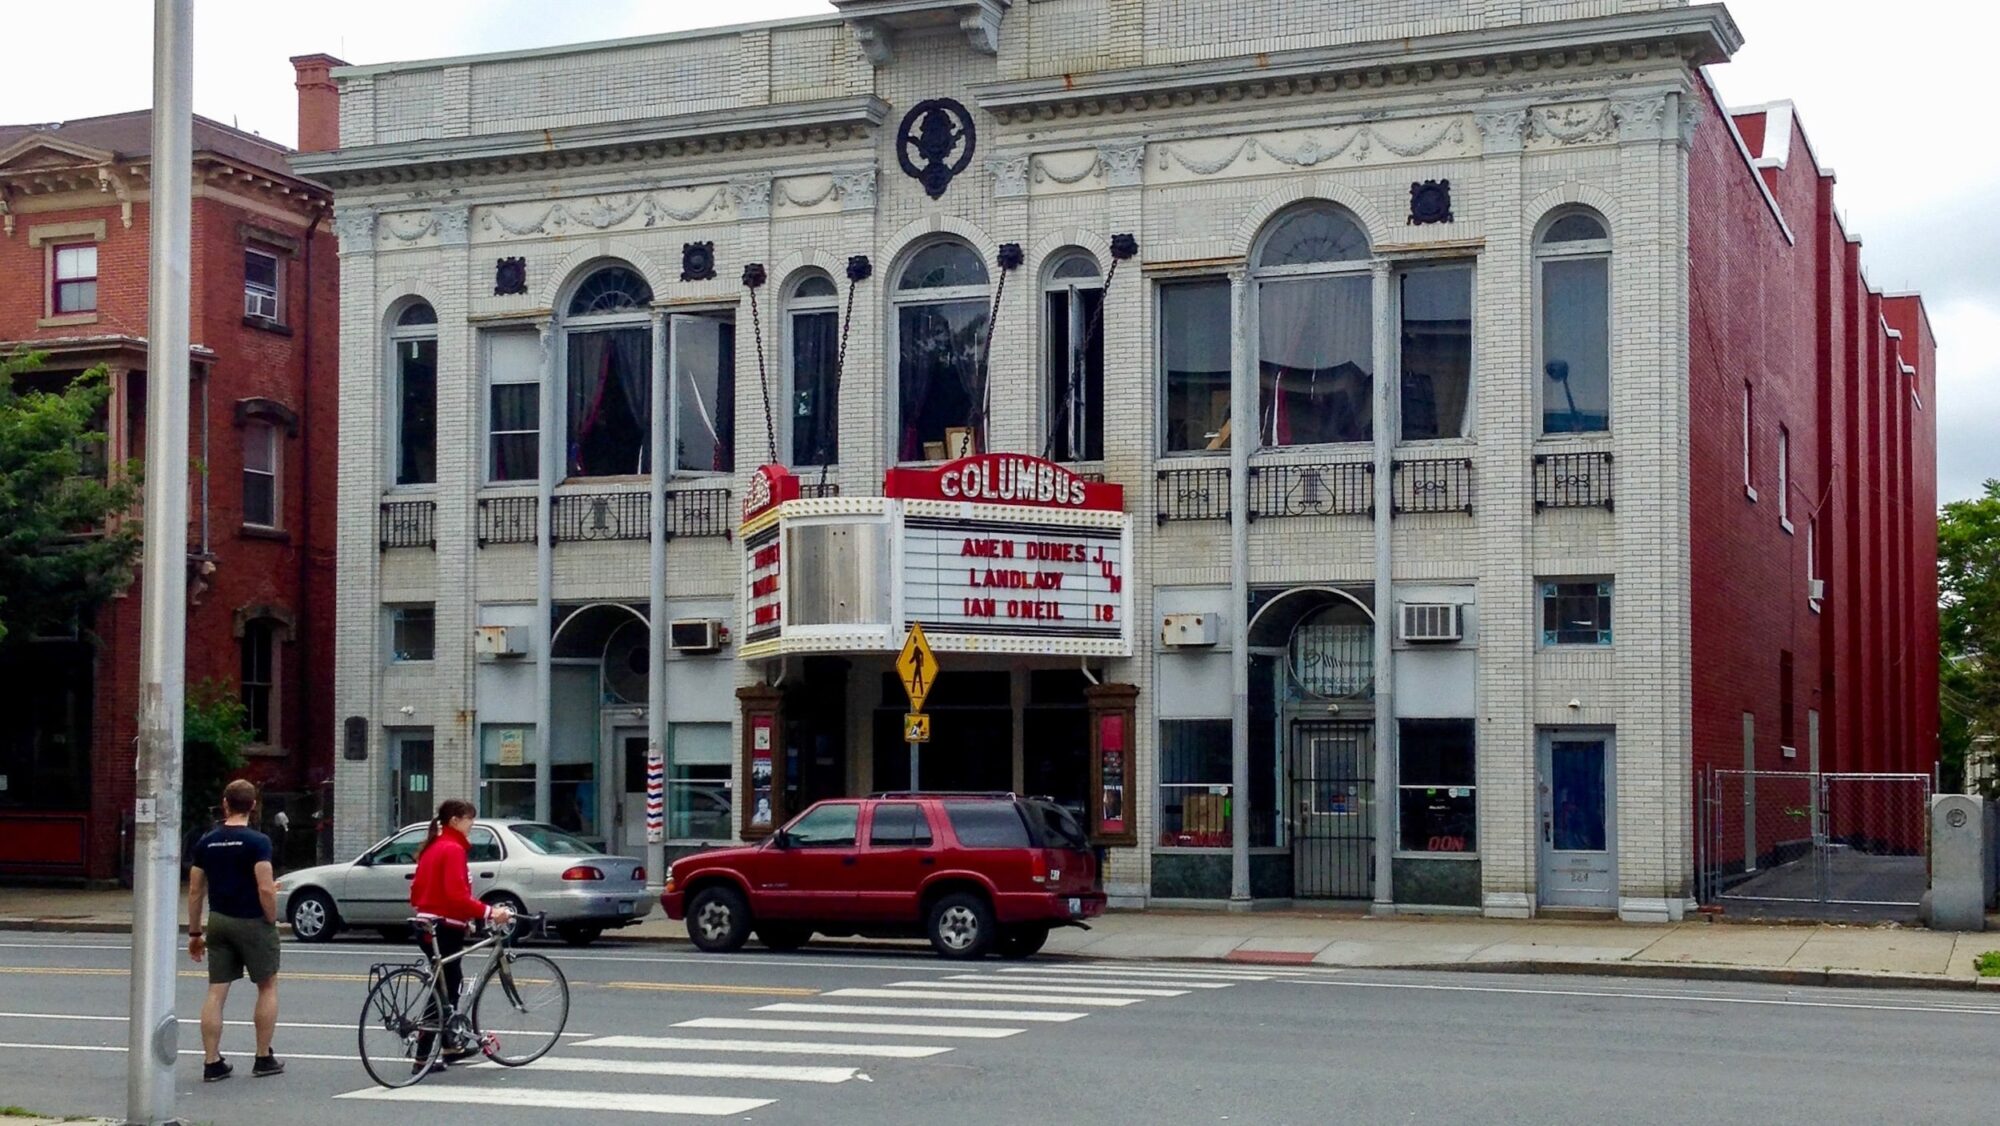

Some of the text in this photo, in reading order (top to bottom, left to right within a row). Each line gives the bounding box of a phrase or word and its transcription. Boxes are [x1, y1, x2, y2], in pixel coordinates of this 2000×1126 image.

[941, 458, 1085, 504] COLUMBUS
[961, 538, 1086, 562] AMEN DUNES
[970, 568, 1063, 590] LANDLADY
[964, 598, 1113, 622] IAN ONEIL 18
